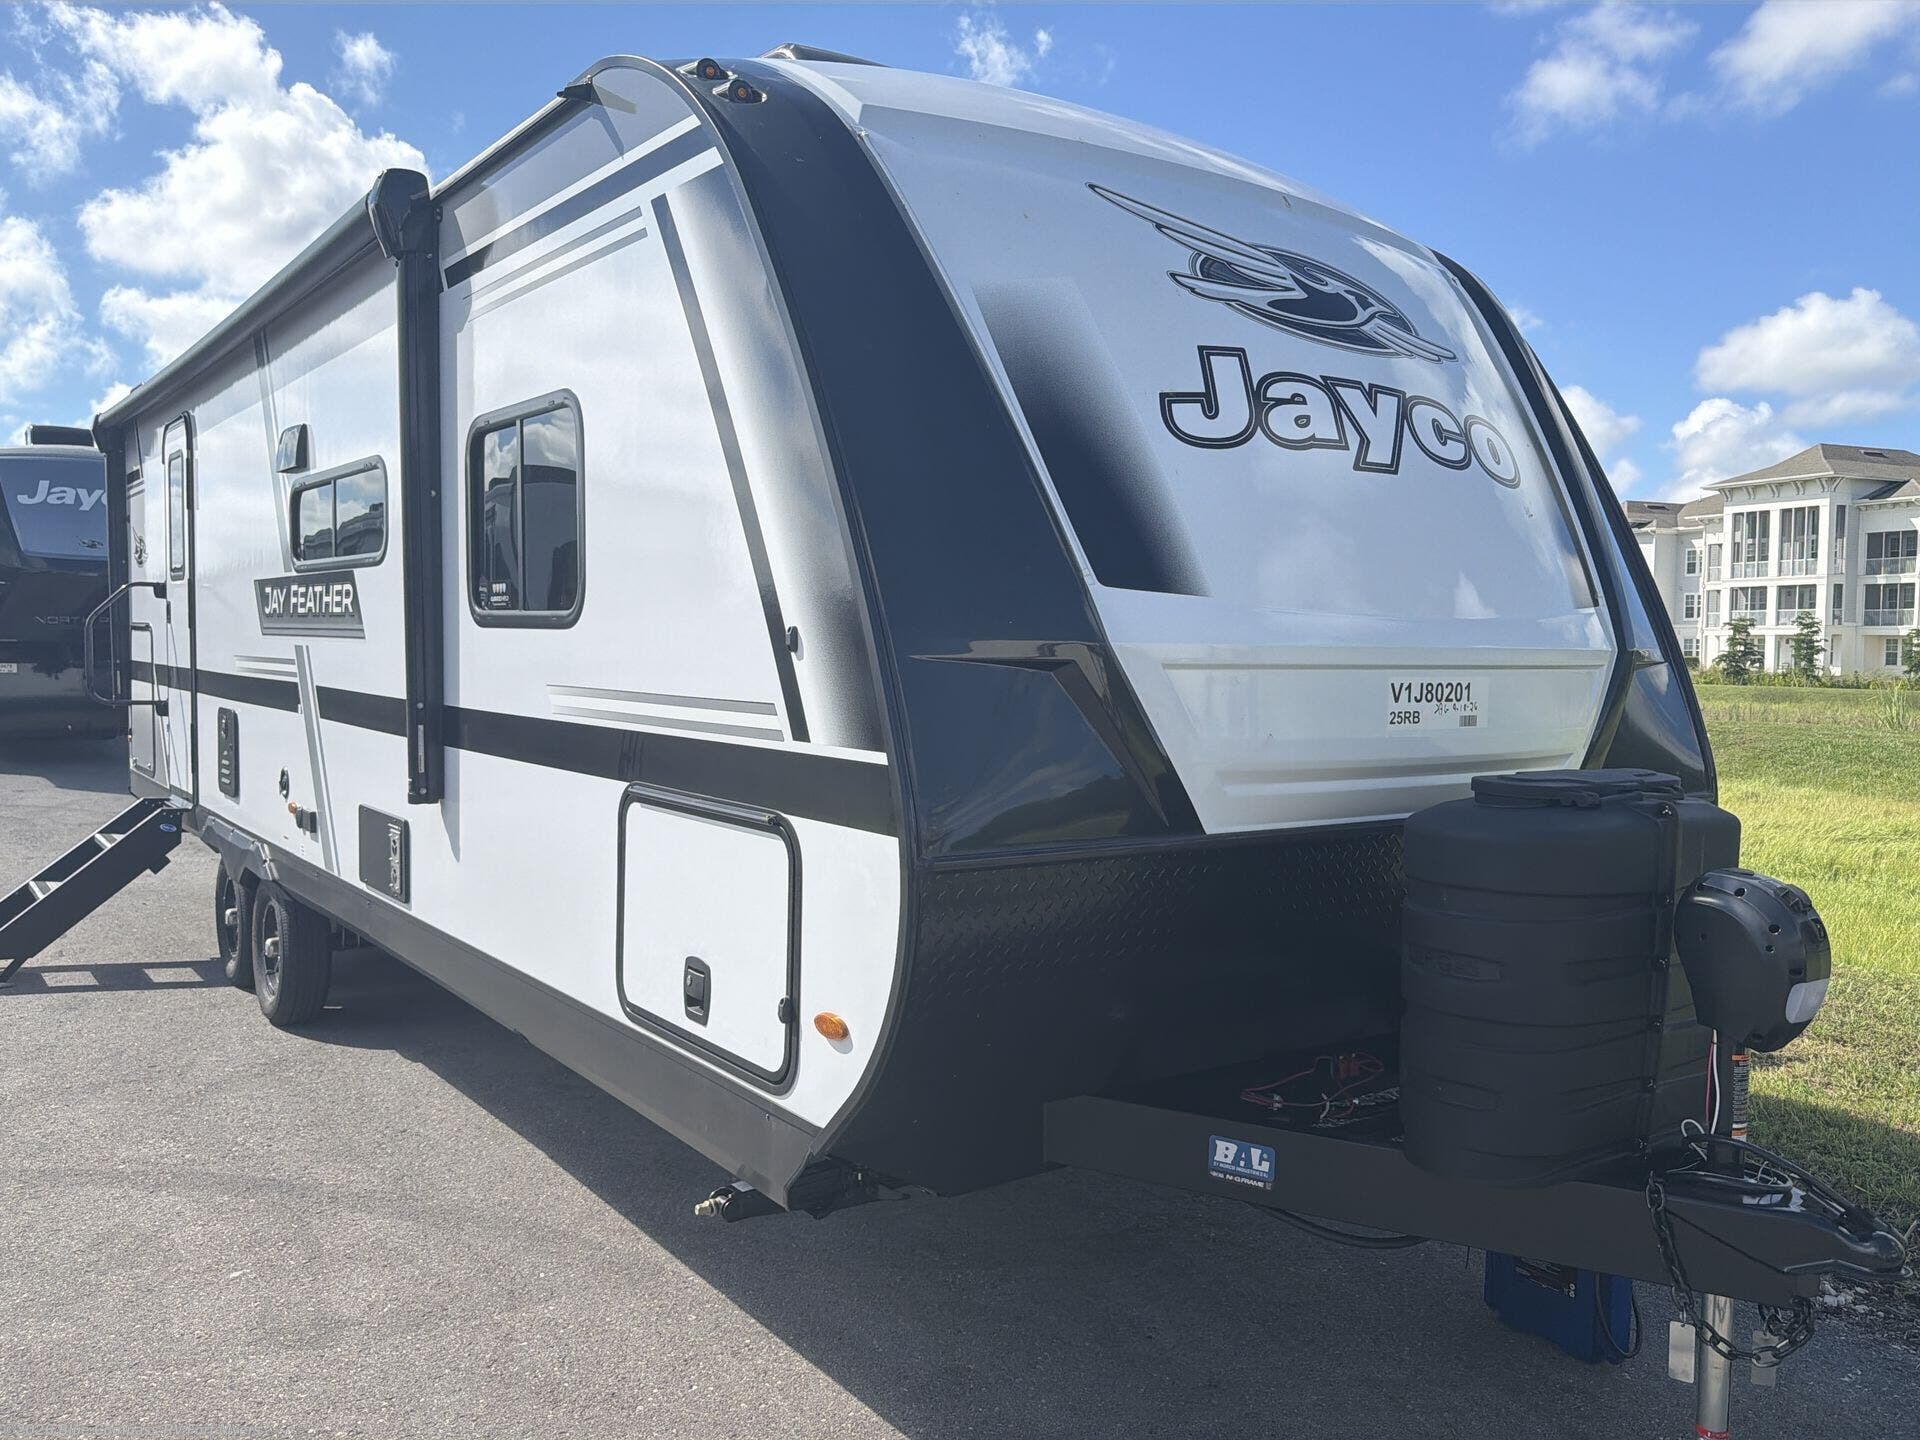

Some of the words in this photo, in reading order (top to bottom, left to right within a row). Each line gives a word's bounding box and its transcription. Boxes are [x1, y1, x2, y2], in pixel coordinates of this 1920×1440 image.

[1159, 345, 1521, 489] Jayco
[264, 586, 287, 615] JAY
[290, 583, 354, 614] FEATHER
[1390, 682, 1472, 703] V1J80201
[1389, 710, 1421, 725] 25RB
